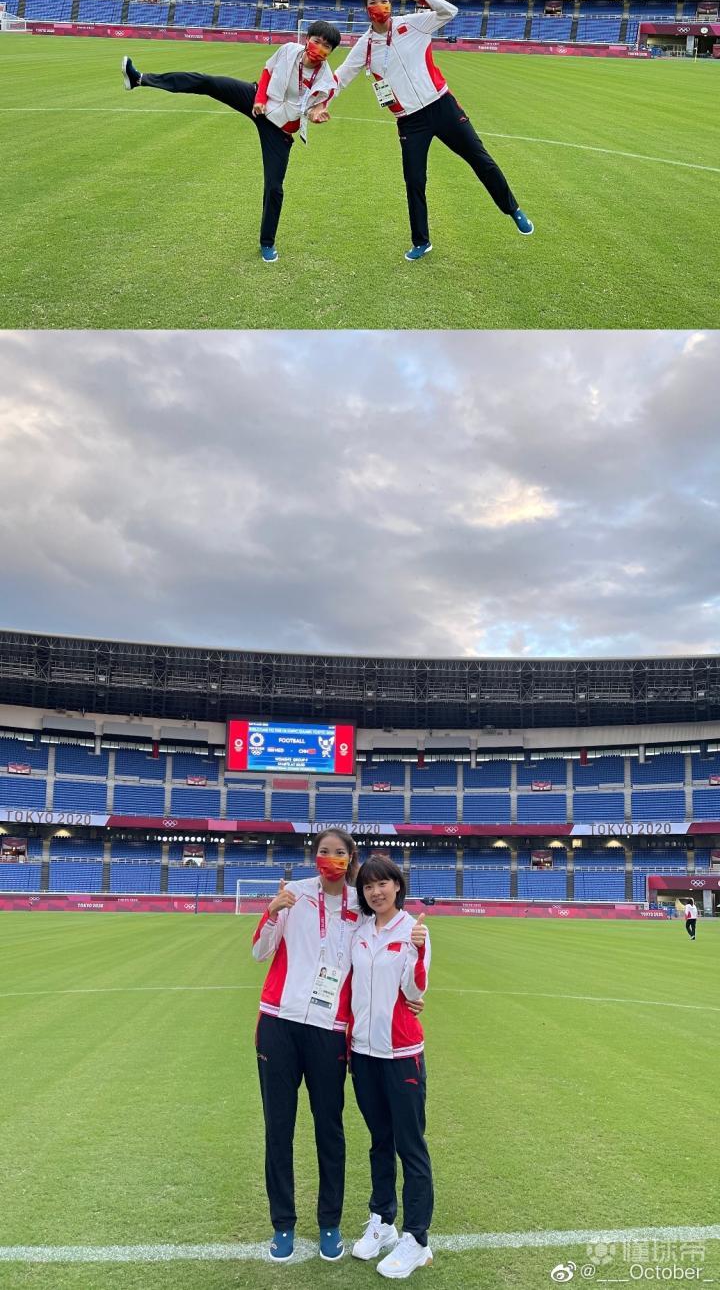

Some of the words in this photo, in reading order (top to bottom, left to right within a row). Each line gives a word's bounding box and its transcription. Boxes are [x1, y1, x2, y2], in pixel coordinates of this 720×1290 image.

[7, 810, 53, 824] TOKYO
[58, 814, 91, 826] 2020
[352, 824, 380, 834] 2020
[590, 824, 633, 835] TOKYO
[638, 823, 671, 834] 2020
